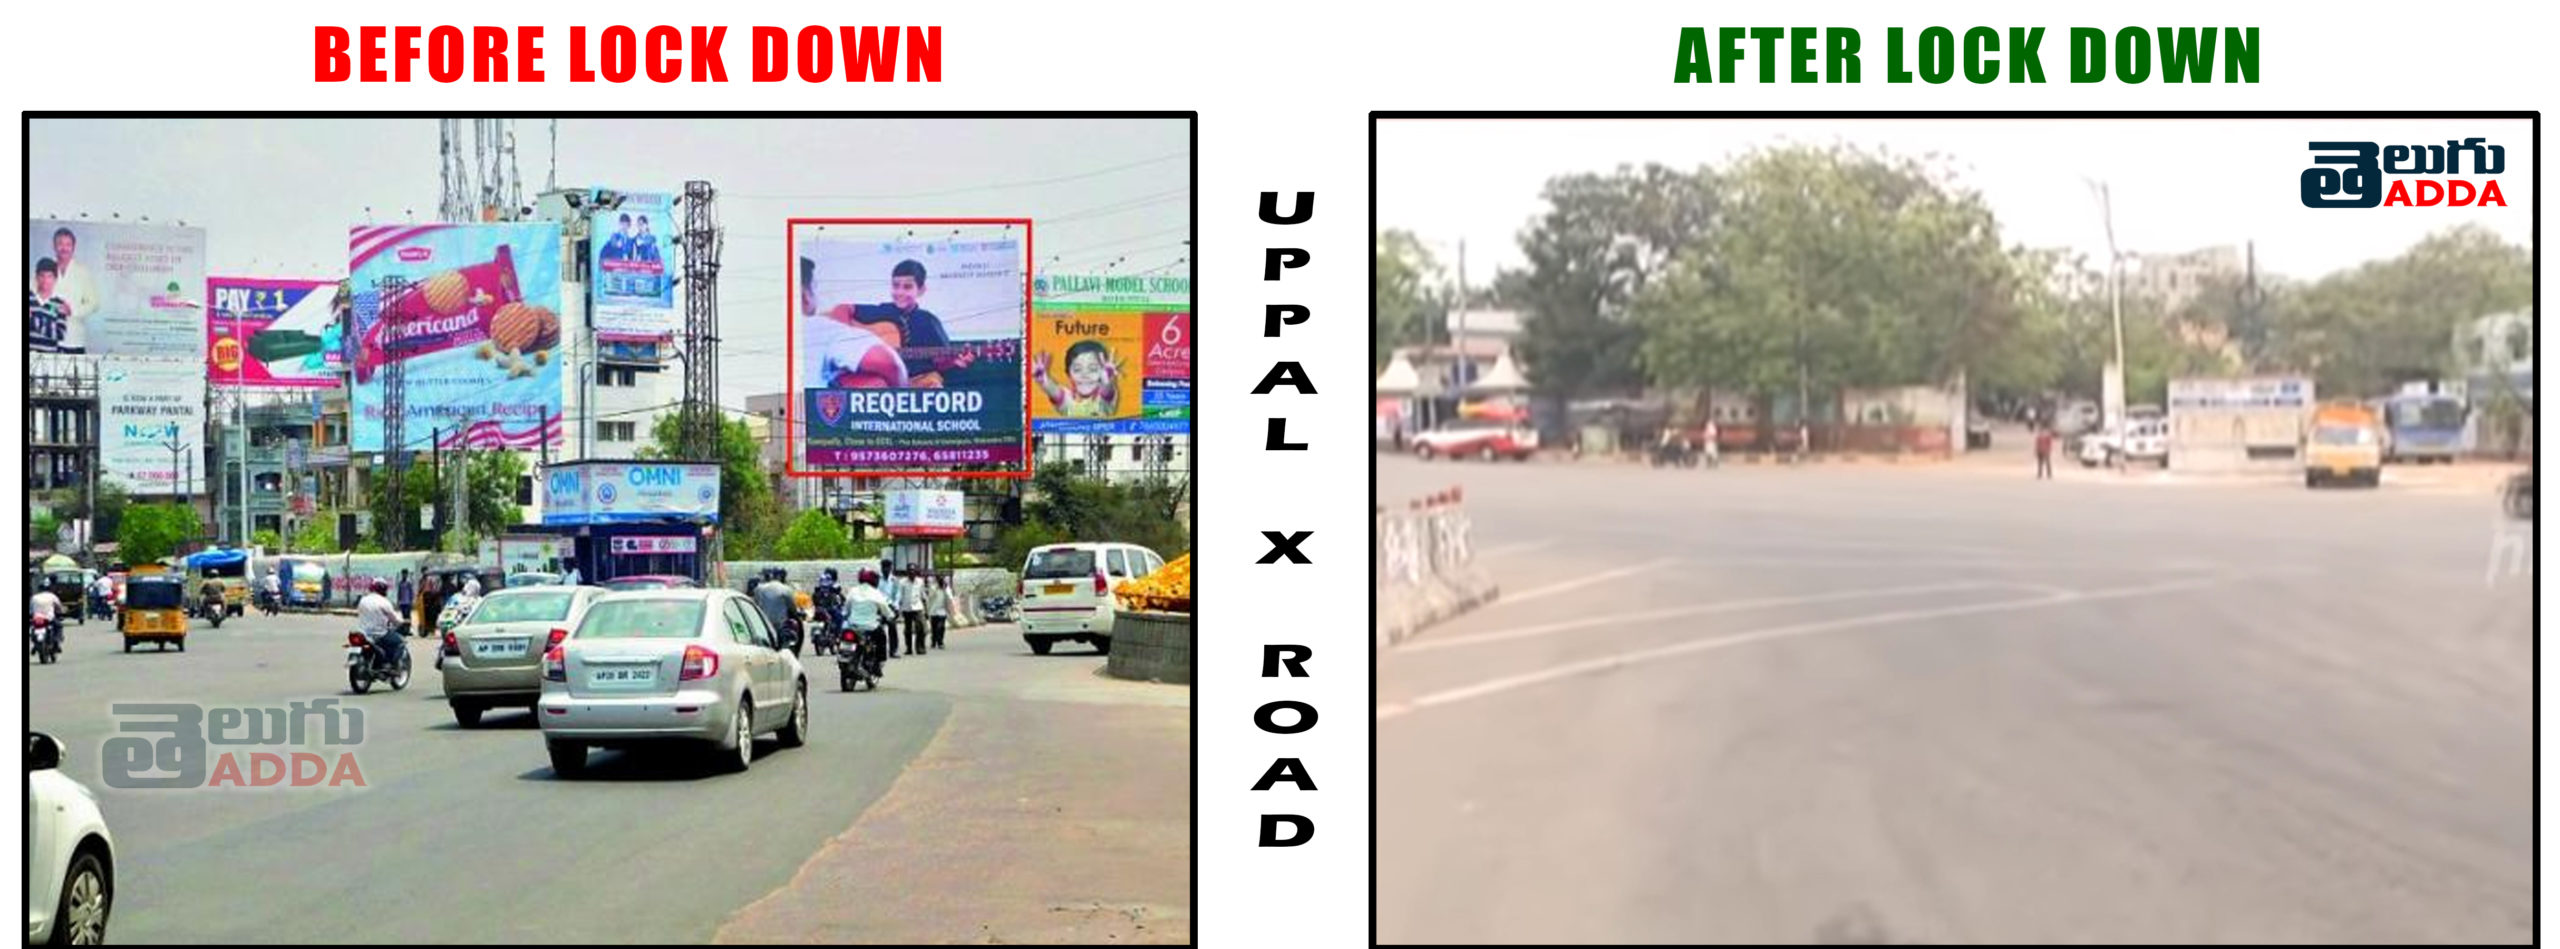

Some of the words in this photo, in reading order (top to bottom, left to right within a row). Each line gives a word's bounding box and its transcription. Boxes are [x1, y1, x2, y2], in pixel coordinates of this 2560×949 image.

[1053, 275, 1100, 292] PALLAVI
[1105, 277, 1144, 293] MODEL
[215, 288, 250, 312] PAY
[274, 289, 288, 311] 1
[1055, 320, 1110, 336] Future
[1161, 315, 1182, 345] 6
[216, 345, 239, 363] BIG
[112, 405, 157, 415] PARKWAY
[851, 391, 983, 418] REQELFORD
[851, 420, 935, 432] INTERNATIONAL
[937, 419, 981, 431] SCHOOL
[550, 472, 580, 495] OMNI
[629, 467, 682, 487] OMNI
